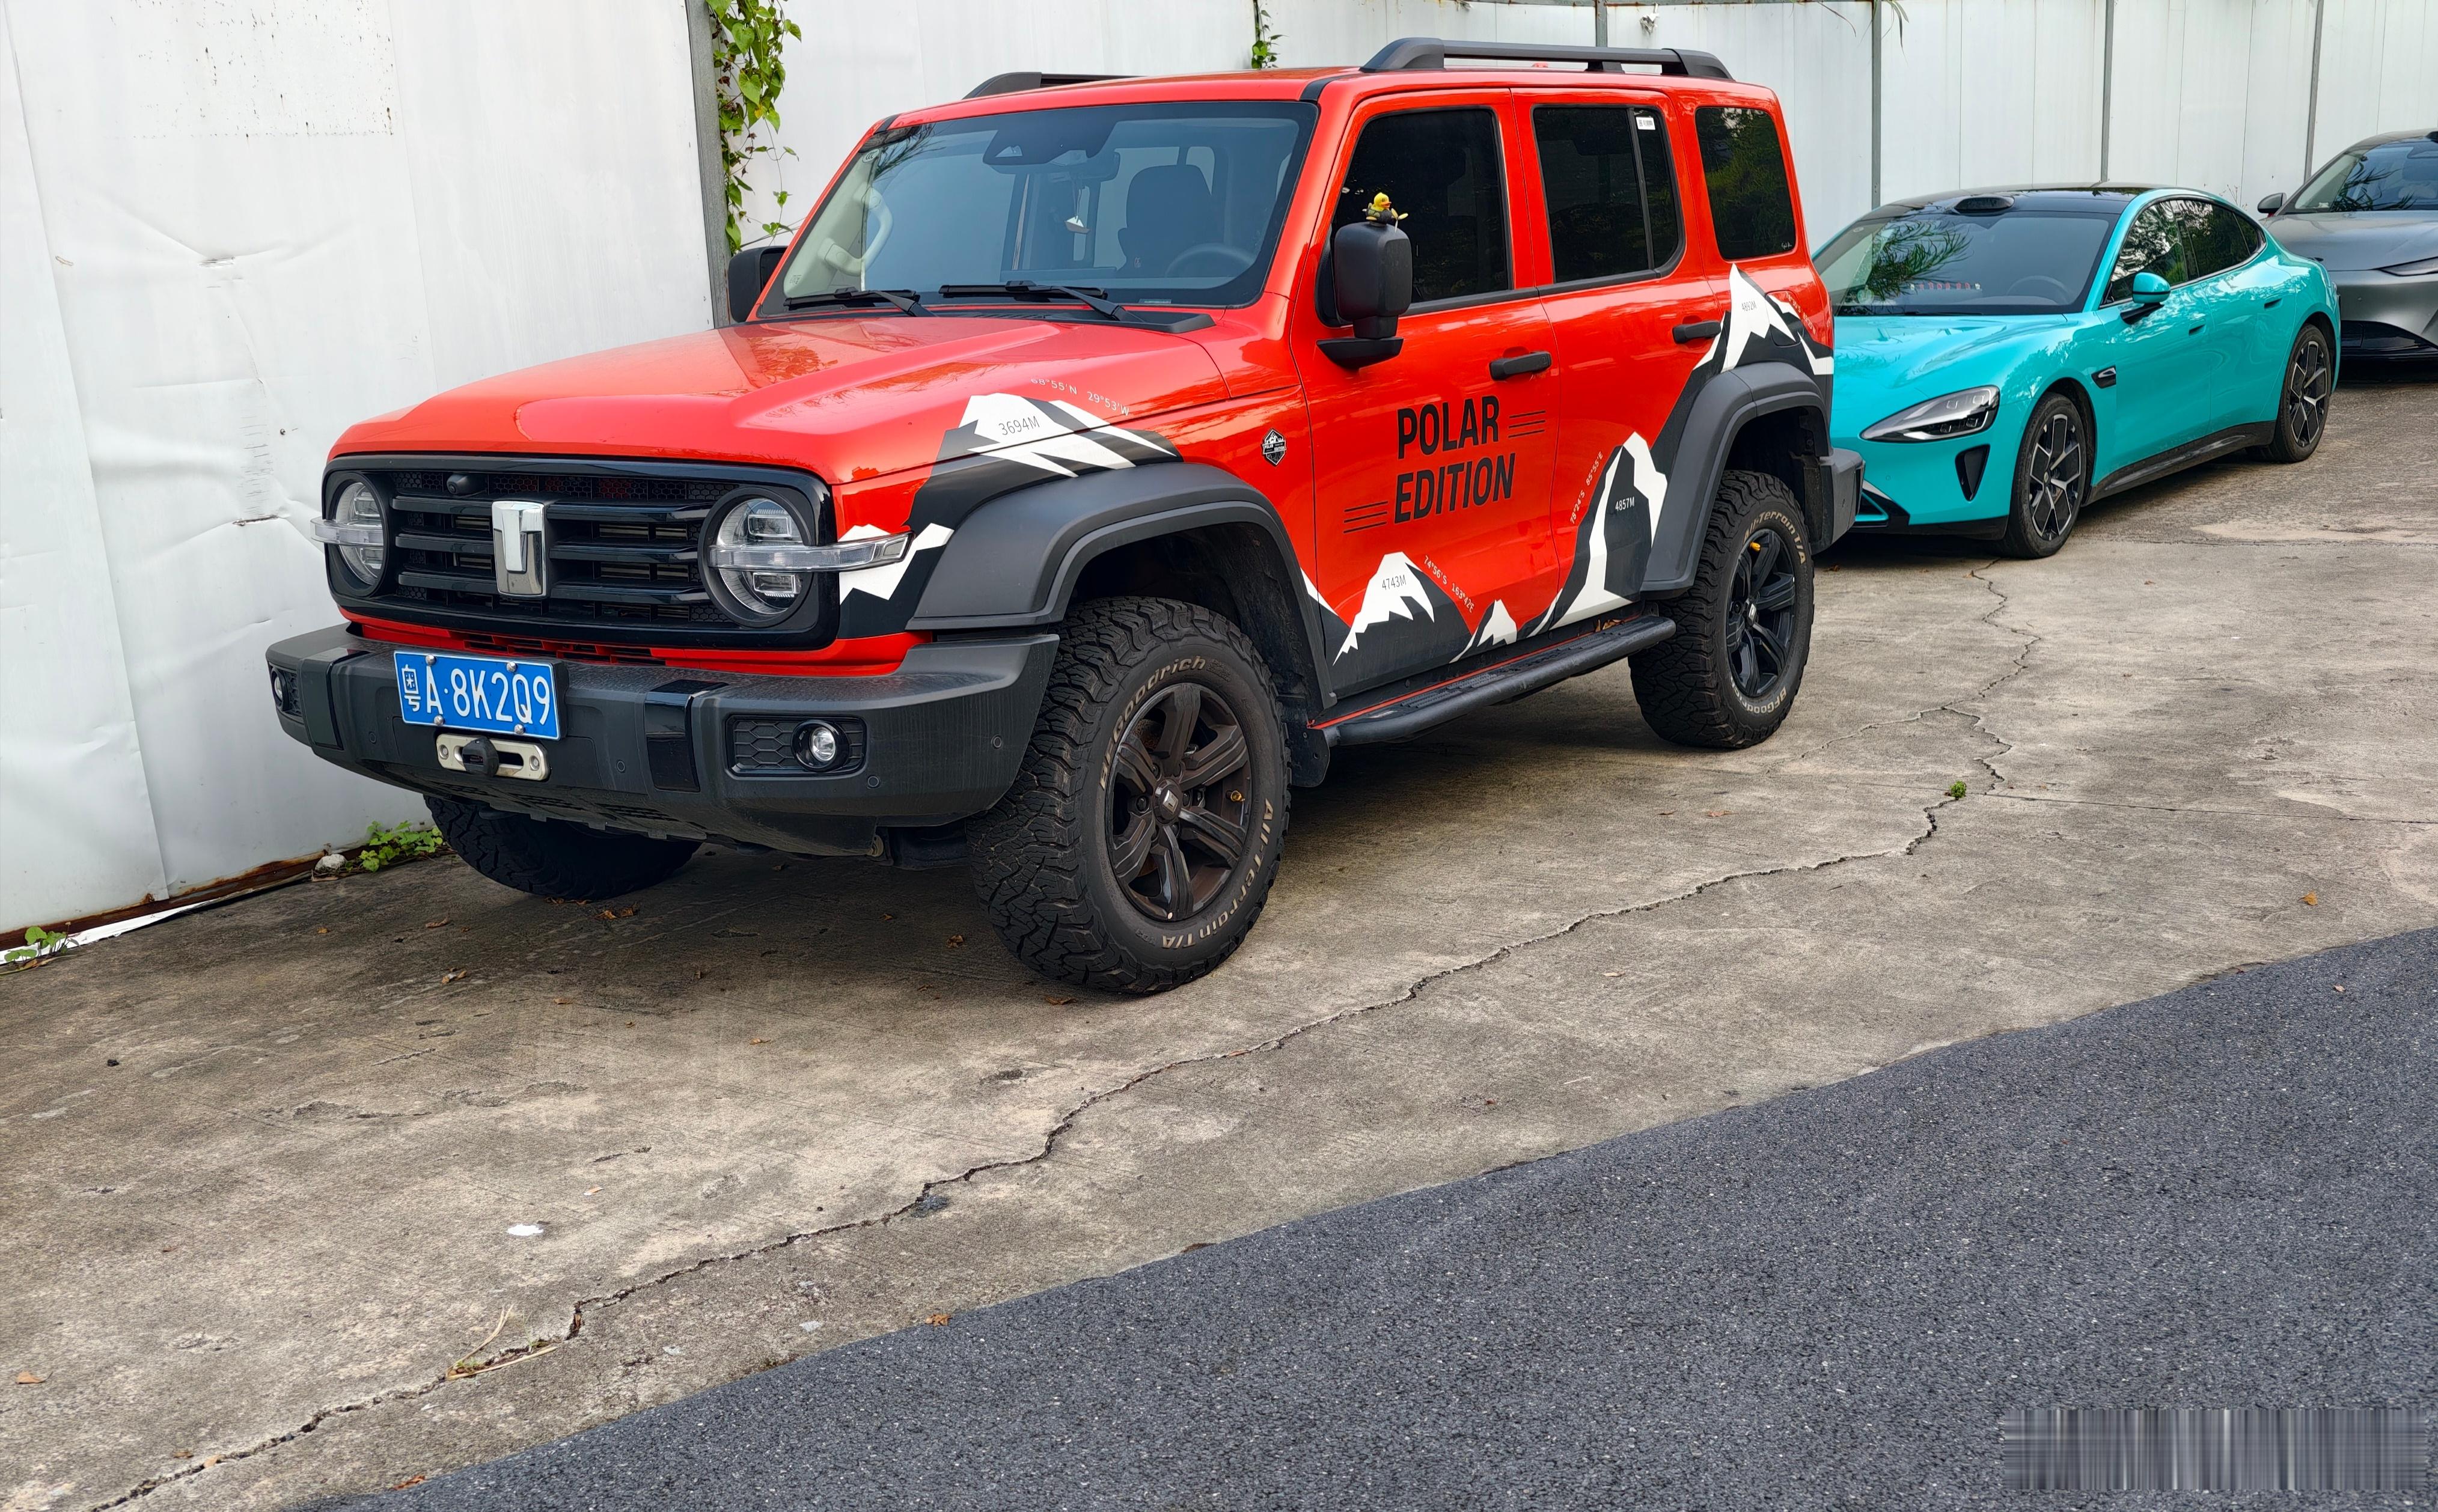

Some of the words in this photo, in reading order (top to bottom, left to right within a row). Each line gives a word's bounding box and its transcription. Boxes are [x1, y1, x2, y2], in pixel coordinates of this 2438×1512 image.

[998, 415, 1040, 436] 3694M
[1397, 395, 1500, 460] POLAR
[1394, 452, 1515, 524] EDITION
[1615, 496, 1635, 512] 4857M
[1382, 574, 1407, 590] 4743M
[1099, 655, 1206, 790] BFGoodrich
